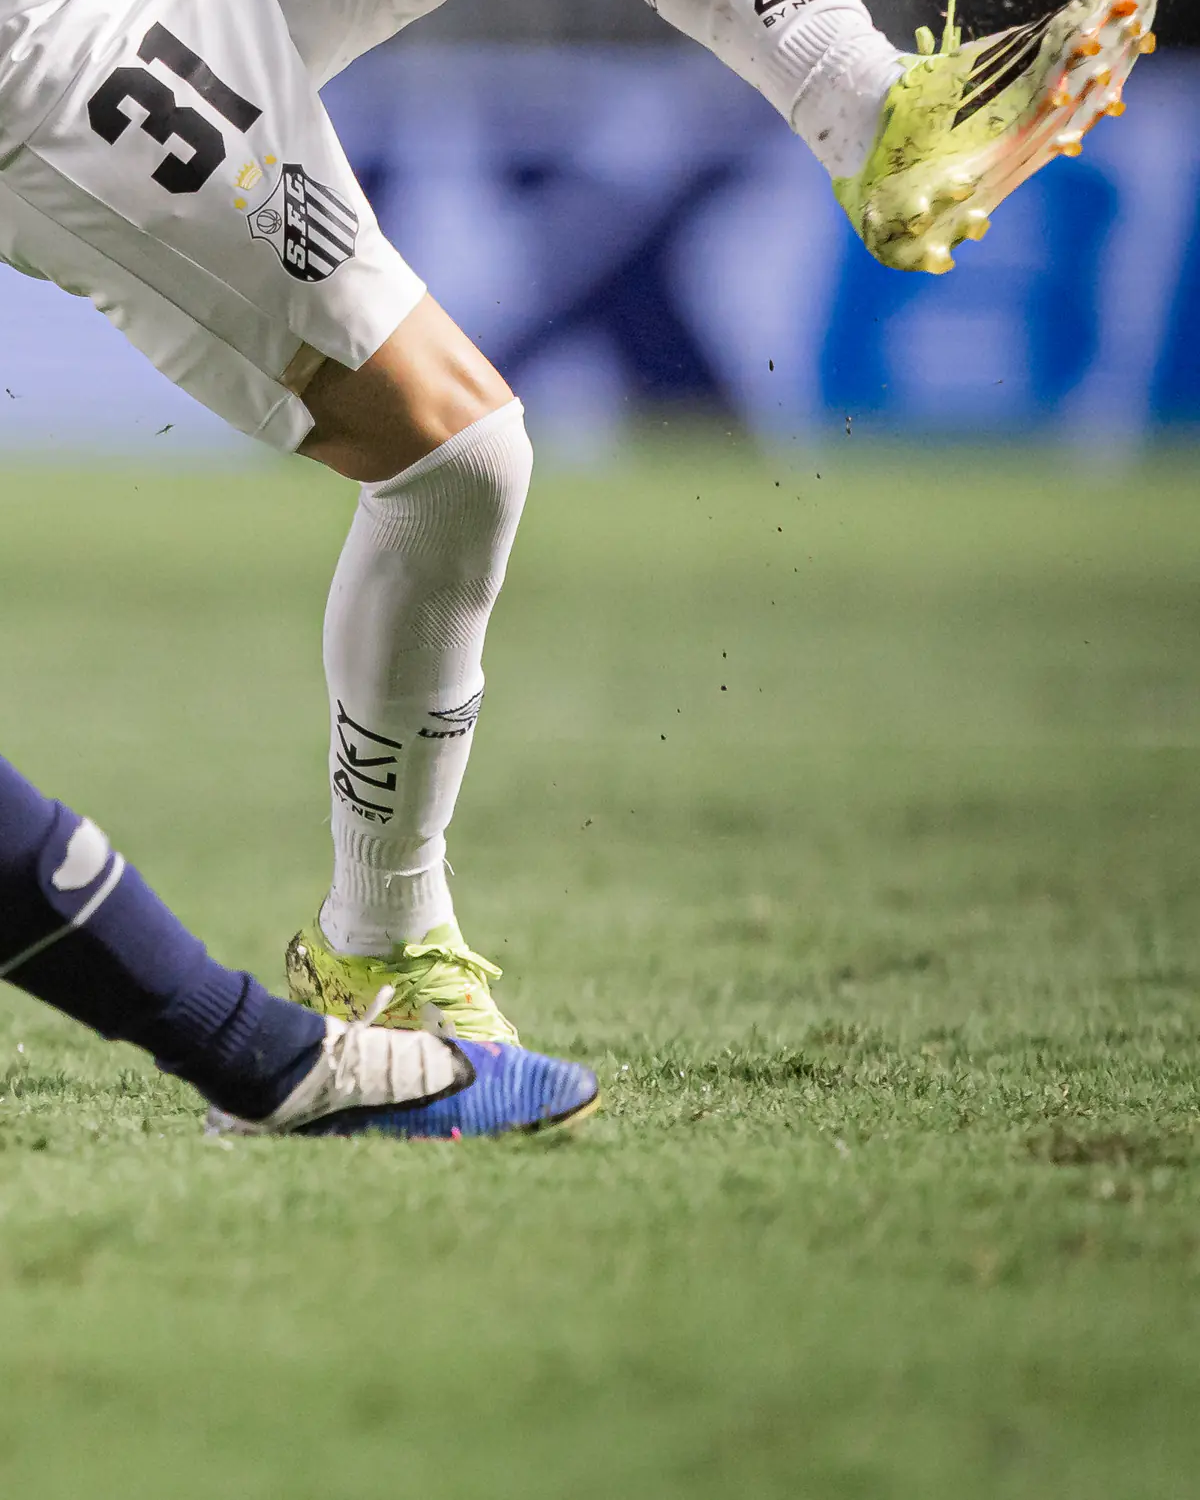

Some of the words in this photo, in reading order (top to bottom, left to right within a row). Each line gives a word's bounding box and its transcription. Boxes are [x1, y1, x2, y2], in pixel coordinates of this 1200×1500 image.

[762, 7, 786, 29] BY
[87, 21, 263, 194] 31
[352, 804, 394, 825] NEY
